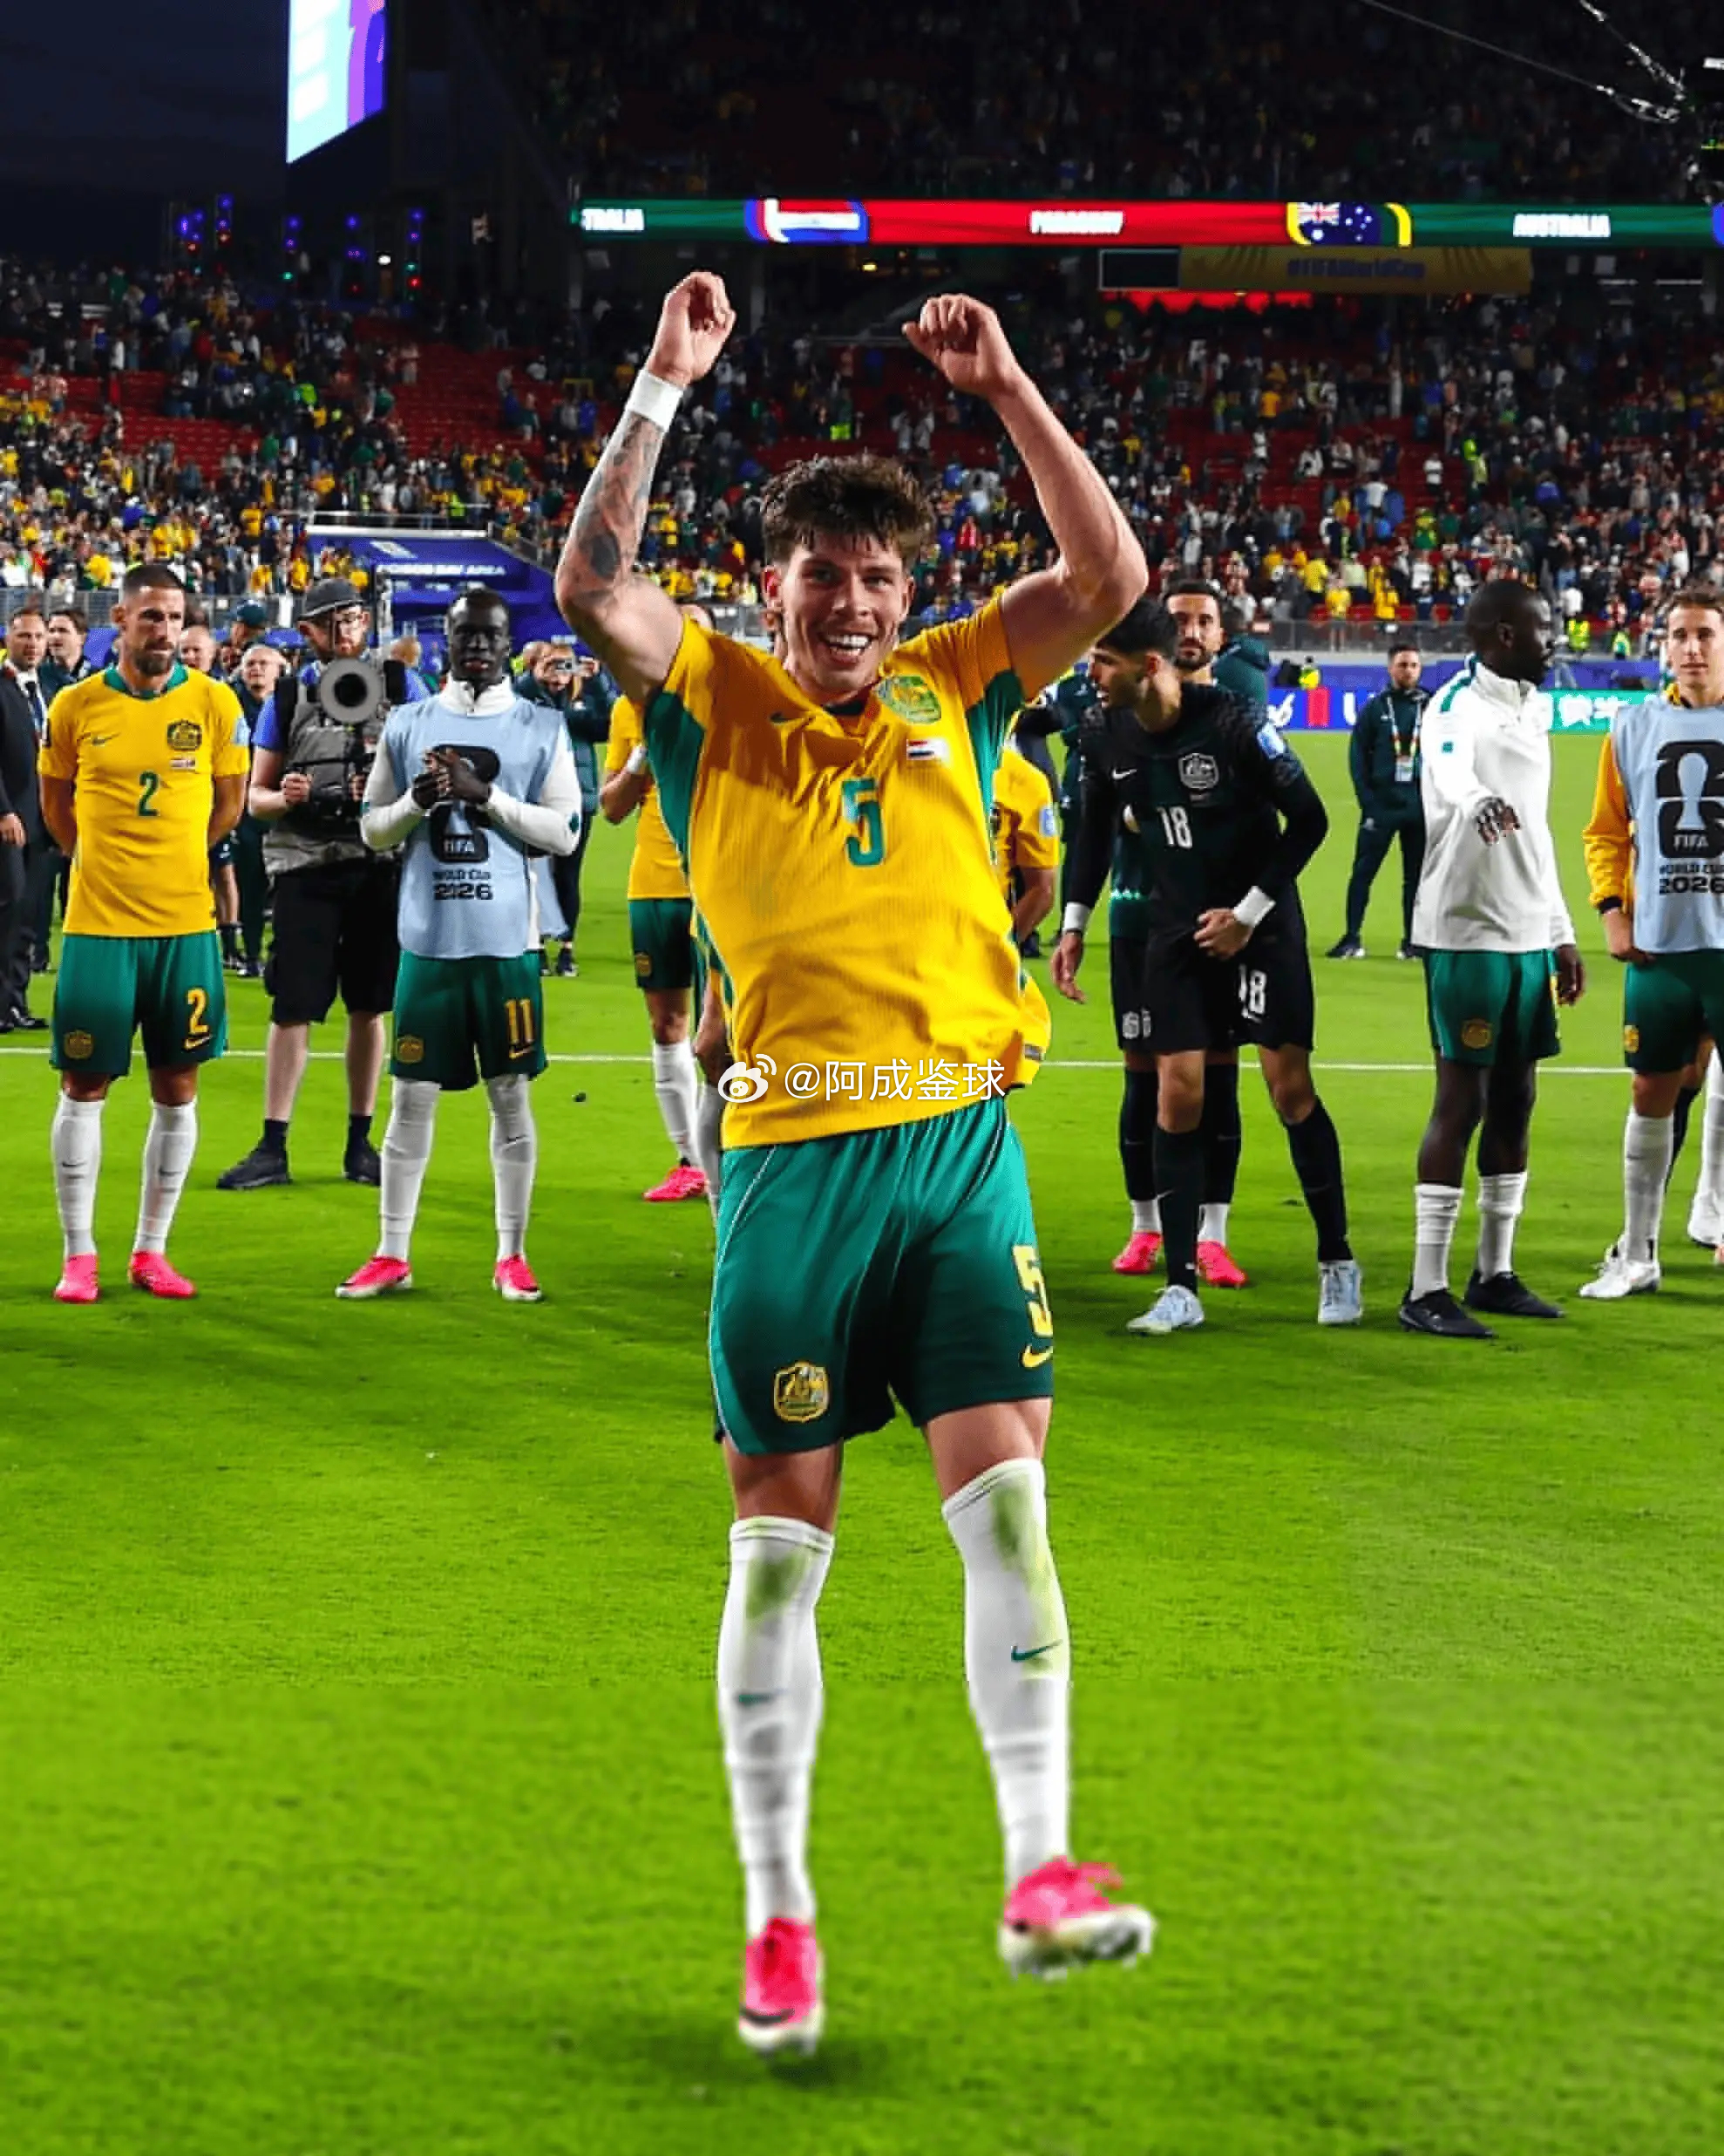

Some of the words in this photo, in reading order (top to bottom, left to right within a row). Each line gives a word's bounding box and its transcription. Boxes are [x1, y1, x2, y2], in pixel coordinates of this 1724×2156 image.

[1512, 213, 1611, 238] AUSTRALIA
[138, 771, 160, 817] 2
[841, 778, 885, 867] 5
[1157, 806, 1193, 849] 18
[1673, 833, 1709, 848] FIFA
[186, 988, 209, 1035] 2
[1238, 964, 1267, 1016] 18
[504, 997, 534, 1044] 11
[1012, 1244, 1054, 1338] 5
